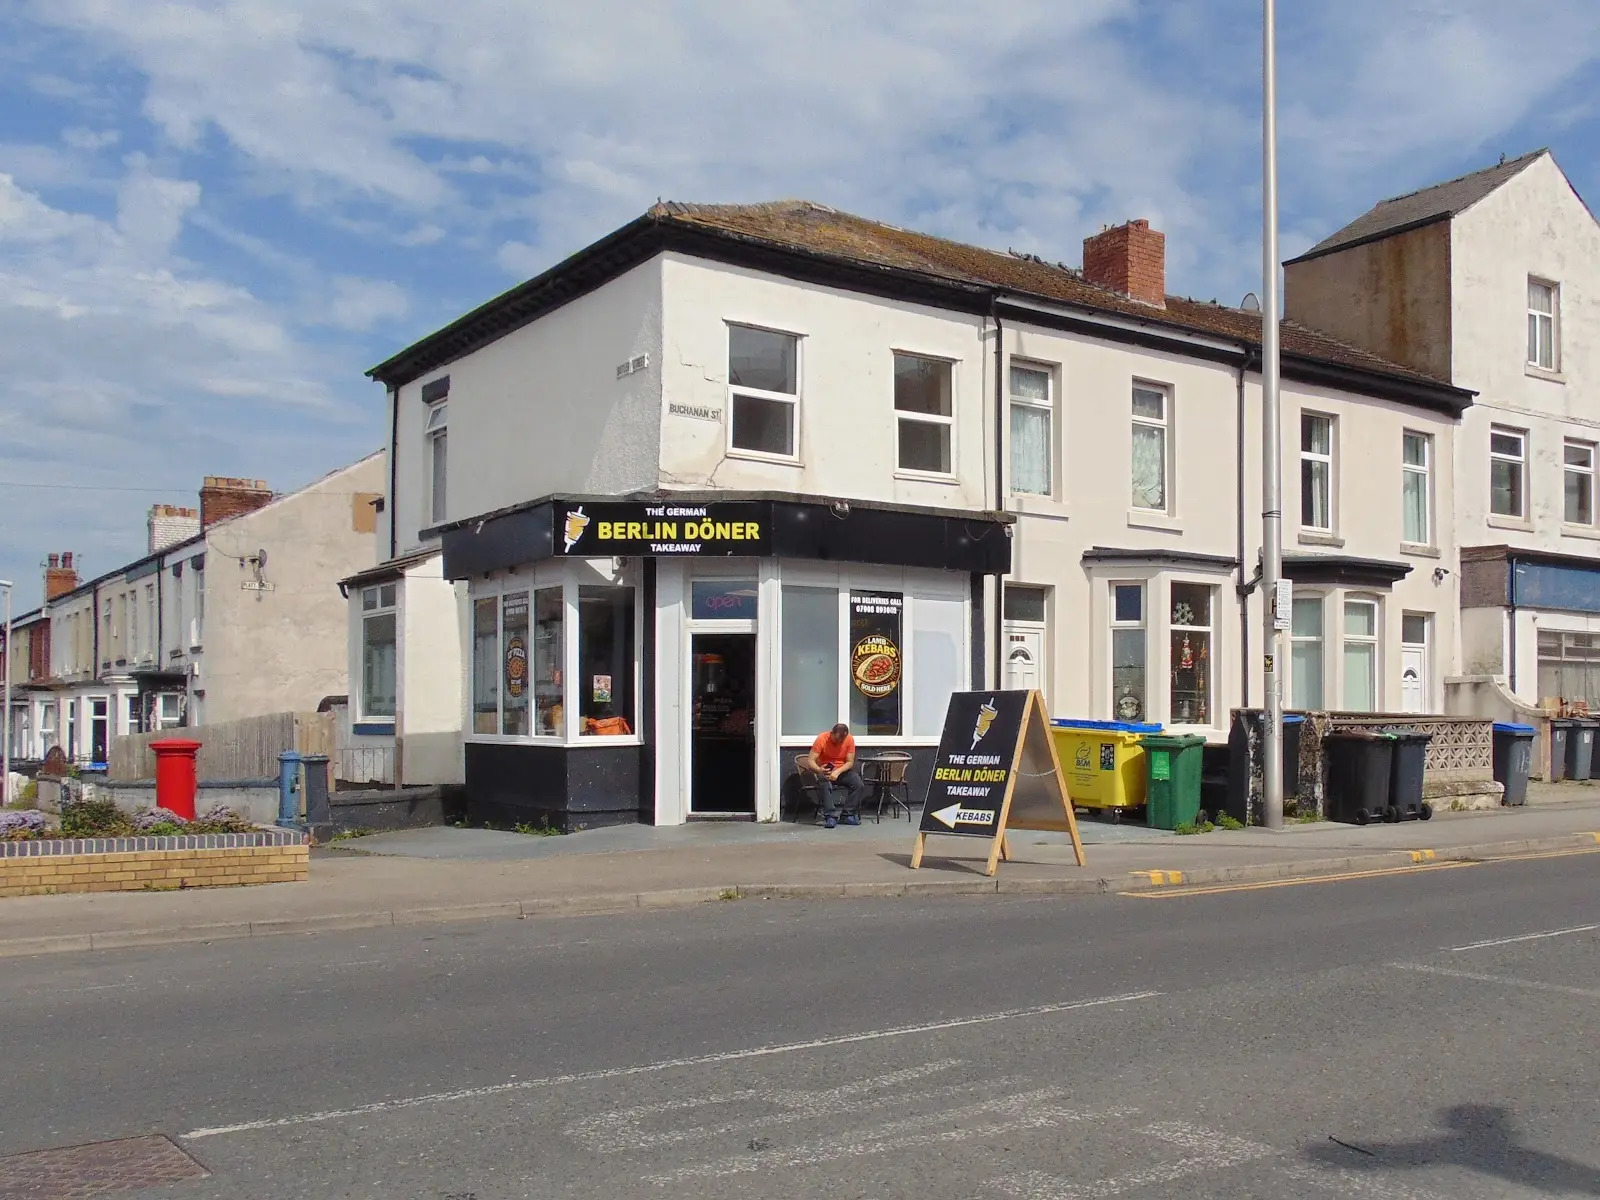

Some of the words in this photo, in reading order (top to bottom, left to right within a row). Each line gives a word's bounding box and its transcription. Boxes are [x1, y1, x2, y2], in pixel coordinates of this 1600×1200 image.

[669, 403, 709, 418] BUCHANAN
[646, 507, 665, 516] THE
[666, 507, 707, 517] GERMAN
[598, 522, 677, 540] BERLIN
[684, 517, 760, 540] DÖNER
[650, 543, 701, 552] TAKEAWAY
[851, 596, 861, 604] FOR
[862, 597, 889, 605] DELIVERIES
[890, 598, 902, 606] CALL
[868, 637, 887, 645] LAMB
[858, 644, 896, 658] KEBABS
[861, 683, 876, 692] SOLD
[876, 684, 891, 693] HERE
[948, 754, 965, 764] THE
[966, 755, 1000, 765] GERMAN
[935, 768, 973, 781] BERLIN
[973, 766, 1006, 782] DÖNER
[947, 785, 990, 797] TAKEAWAY
[955, 811, 992, 822] KEBABS
